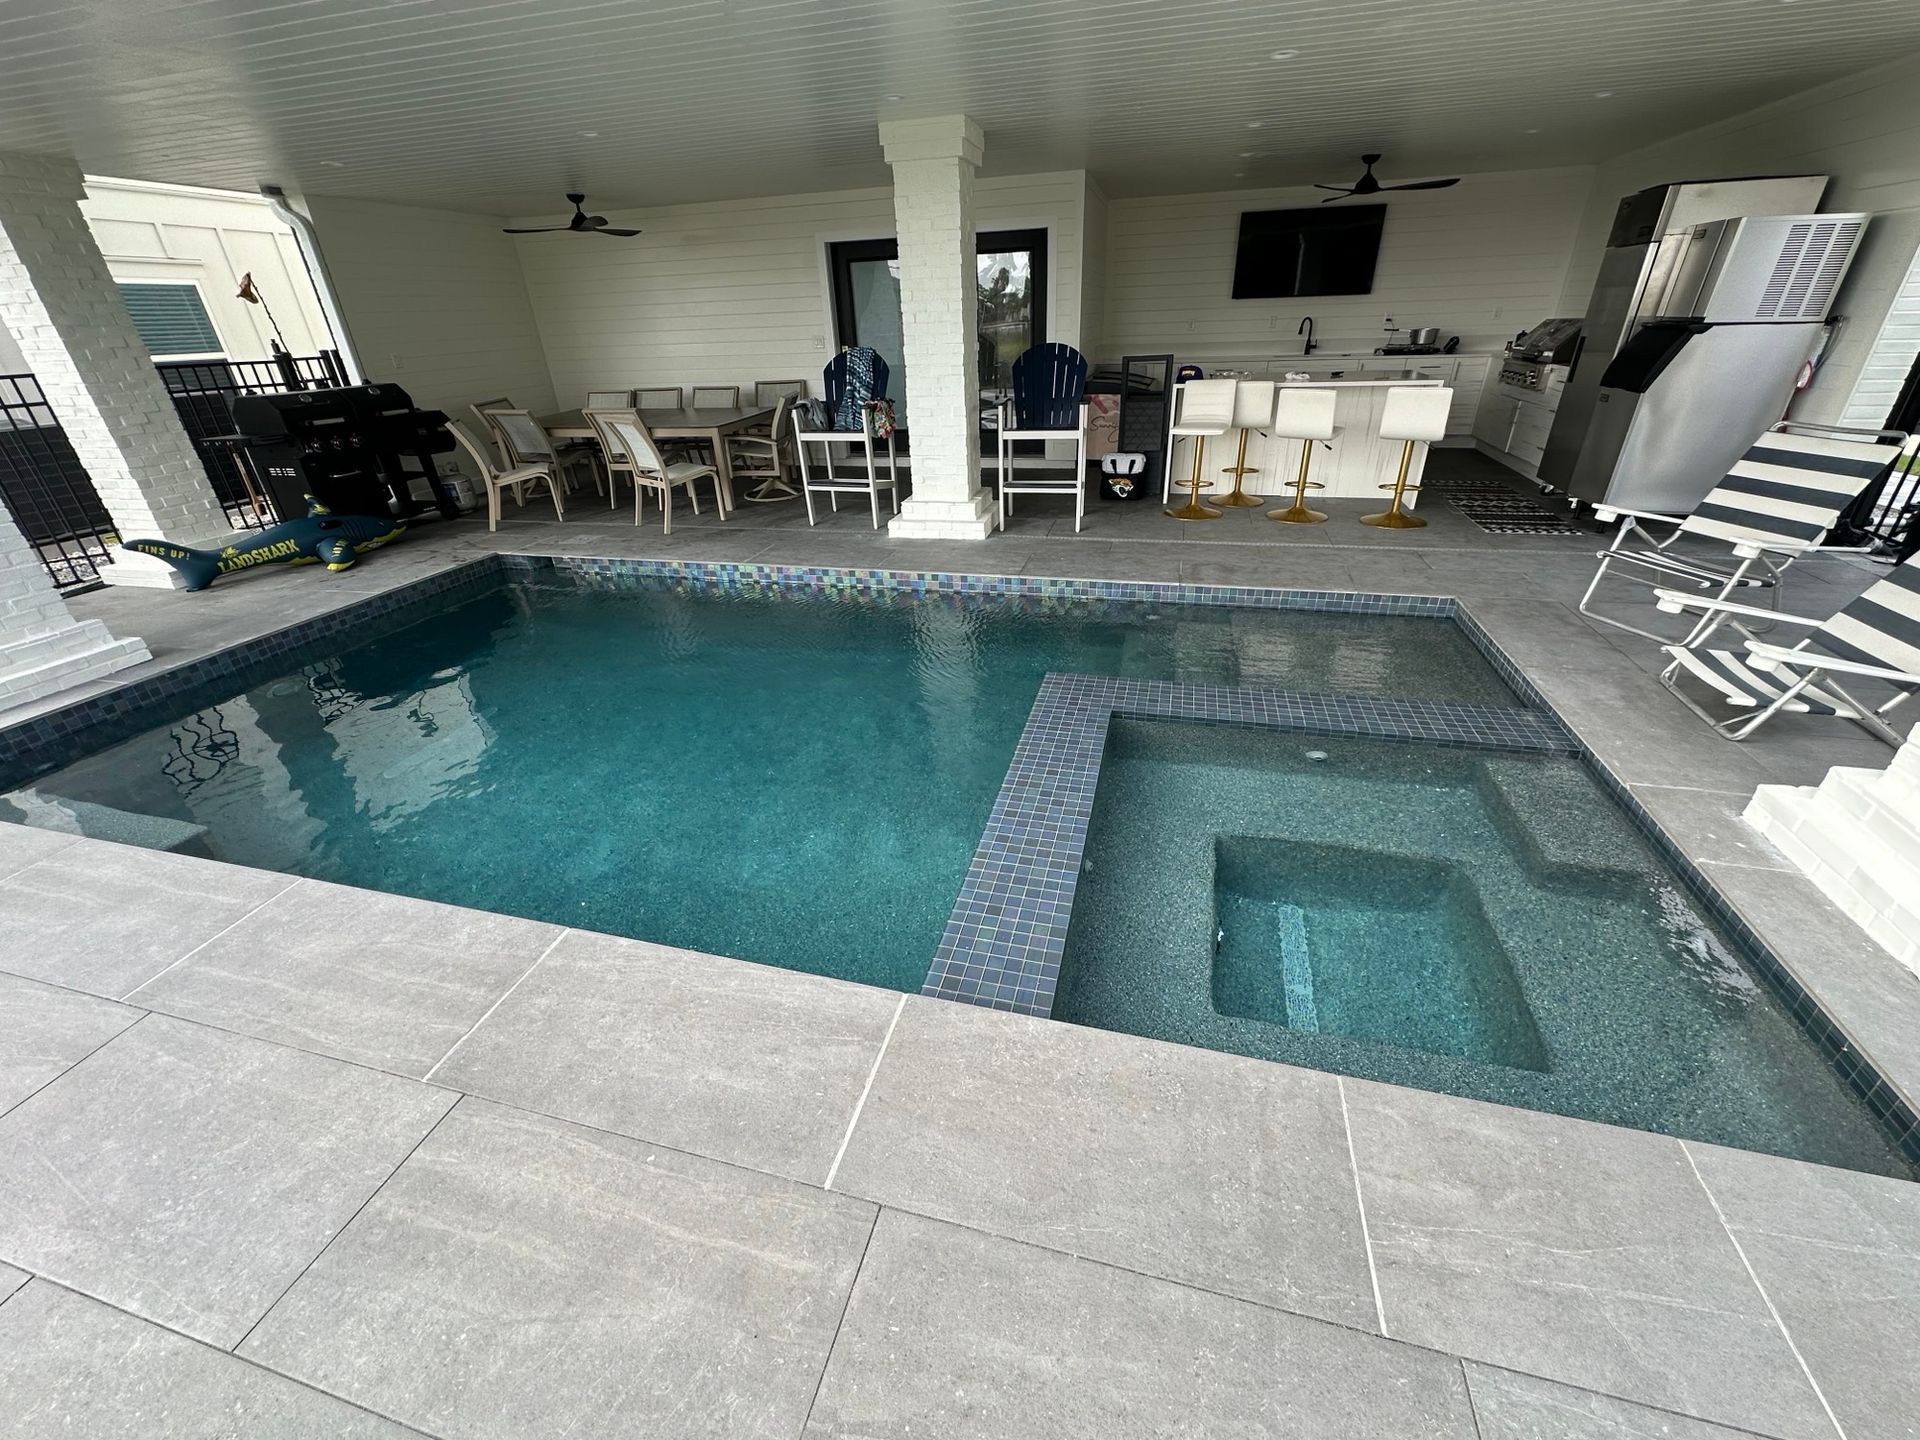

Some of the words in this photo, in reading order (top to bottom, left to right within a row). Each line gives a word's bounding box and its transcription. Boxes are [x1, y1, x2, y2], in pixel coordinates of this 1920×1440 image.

[137, 544, 166, 556] FINS
[170, 549, 190, 560] UP!
[217, 538, 299, 572] LANDSHARK
